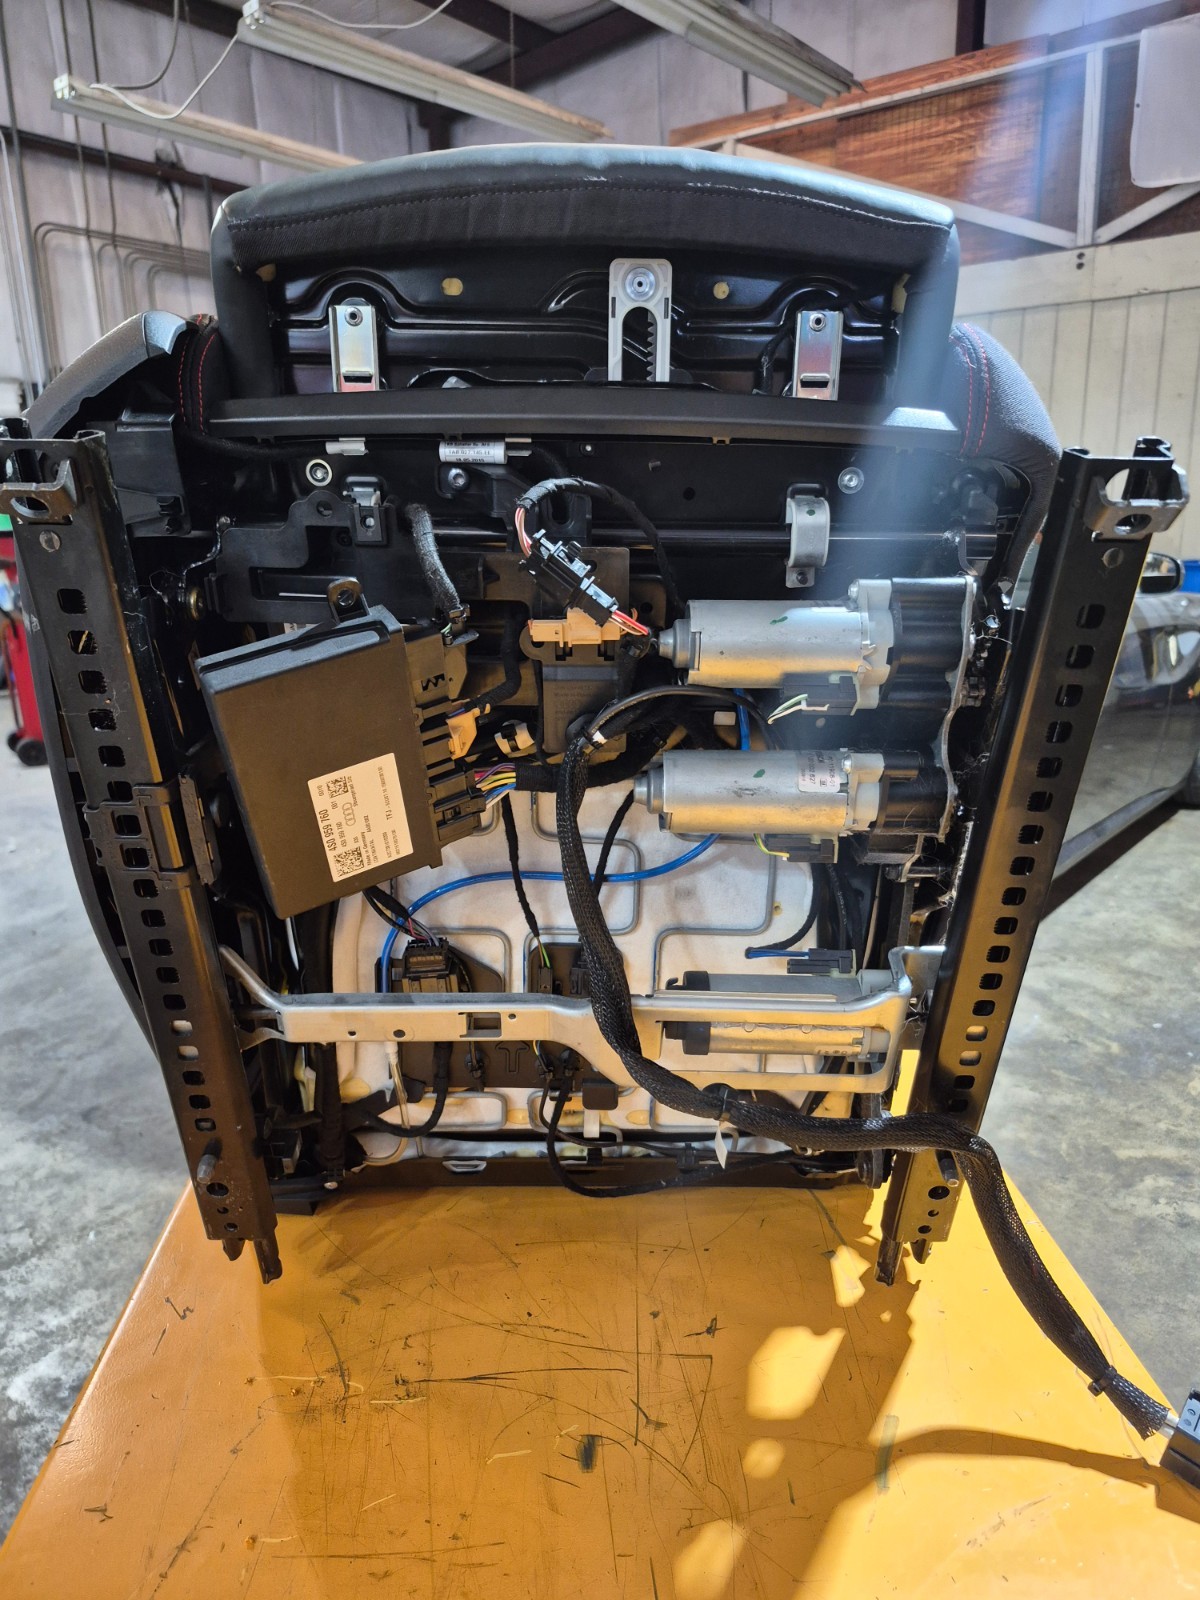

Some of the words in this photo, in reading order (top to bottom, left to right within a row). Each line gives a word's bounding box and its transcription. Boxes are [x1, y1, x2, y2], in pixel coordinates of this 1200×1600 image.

[319, 809, 329, 823] 760
[323, 824, 333, 837] 959
[327, 838, 337, 852] 4S0
[360, 831, 368, 849] Germany
